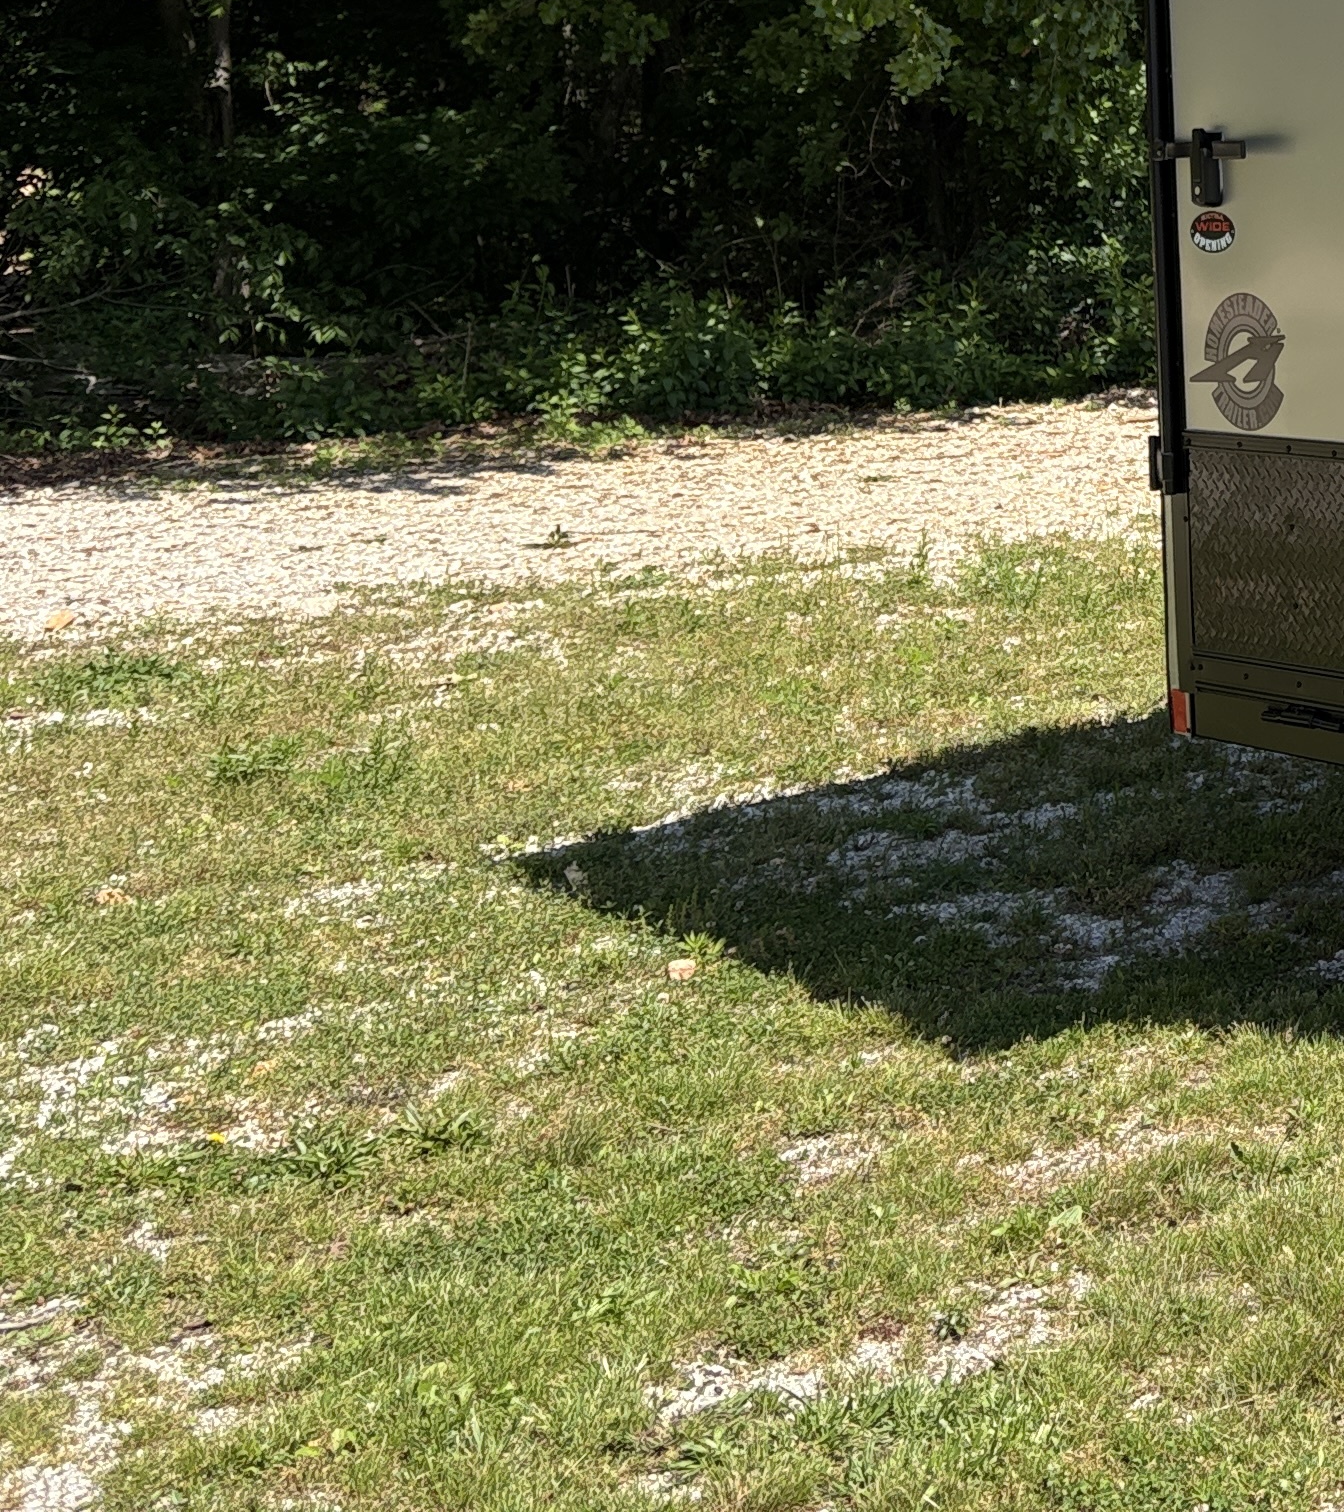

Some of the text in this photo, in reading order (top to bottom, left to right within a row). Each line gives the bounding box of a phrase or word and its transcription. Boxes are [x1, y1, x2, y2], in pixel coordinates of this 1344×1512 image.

[1195, 221, 1230, 232] WIDE
[1193, 231, 1233, 252] OPENING
[1204, 293, 1277, 364] HOMESTEADER
